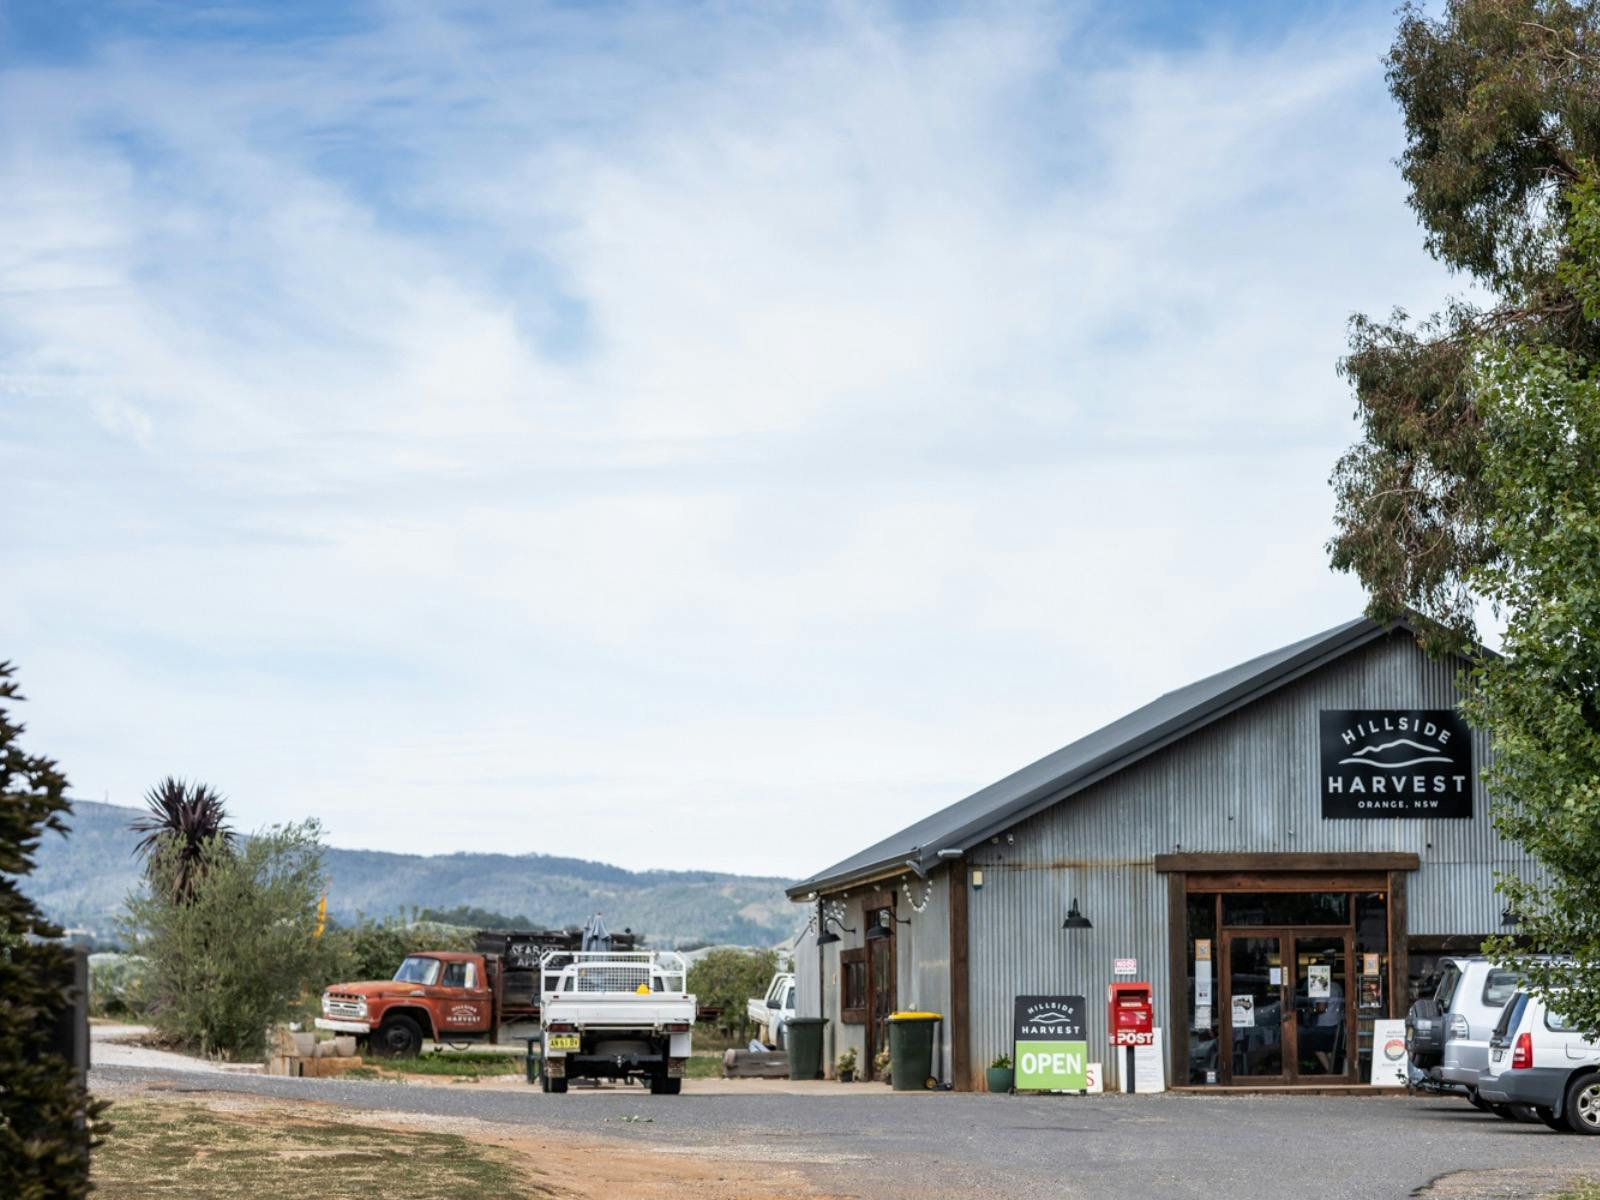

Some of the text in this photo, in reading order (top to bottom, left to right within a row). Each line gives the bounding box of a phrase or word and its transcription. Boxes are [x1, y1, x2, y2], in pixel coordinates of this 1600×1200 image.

[1341, 717, 1451, 745] HILLSIDE
[1328, 775, 1466, 793] HARVEST
[1357, 800, 1439, 809] ORANGE, NSW
[1027, 1002, 1075, 1014] HILLSIDE
[1021, 1026, 1081, 1035] HARVEST
[1117, 1032, 1153, 1045] POST
[1021, 1053, 1081, 1075] OPEN
